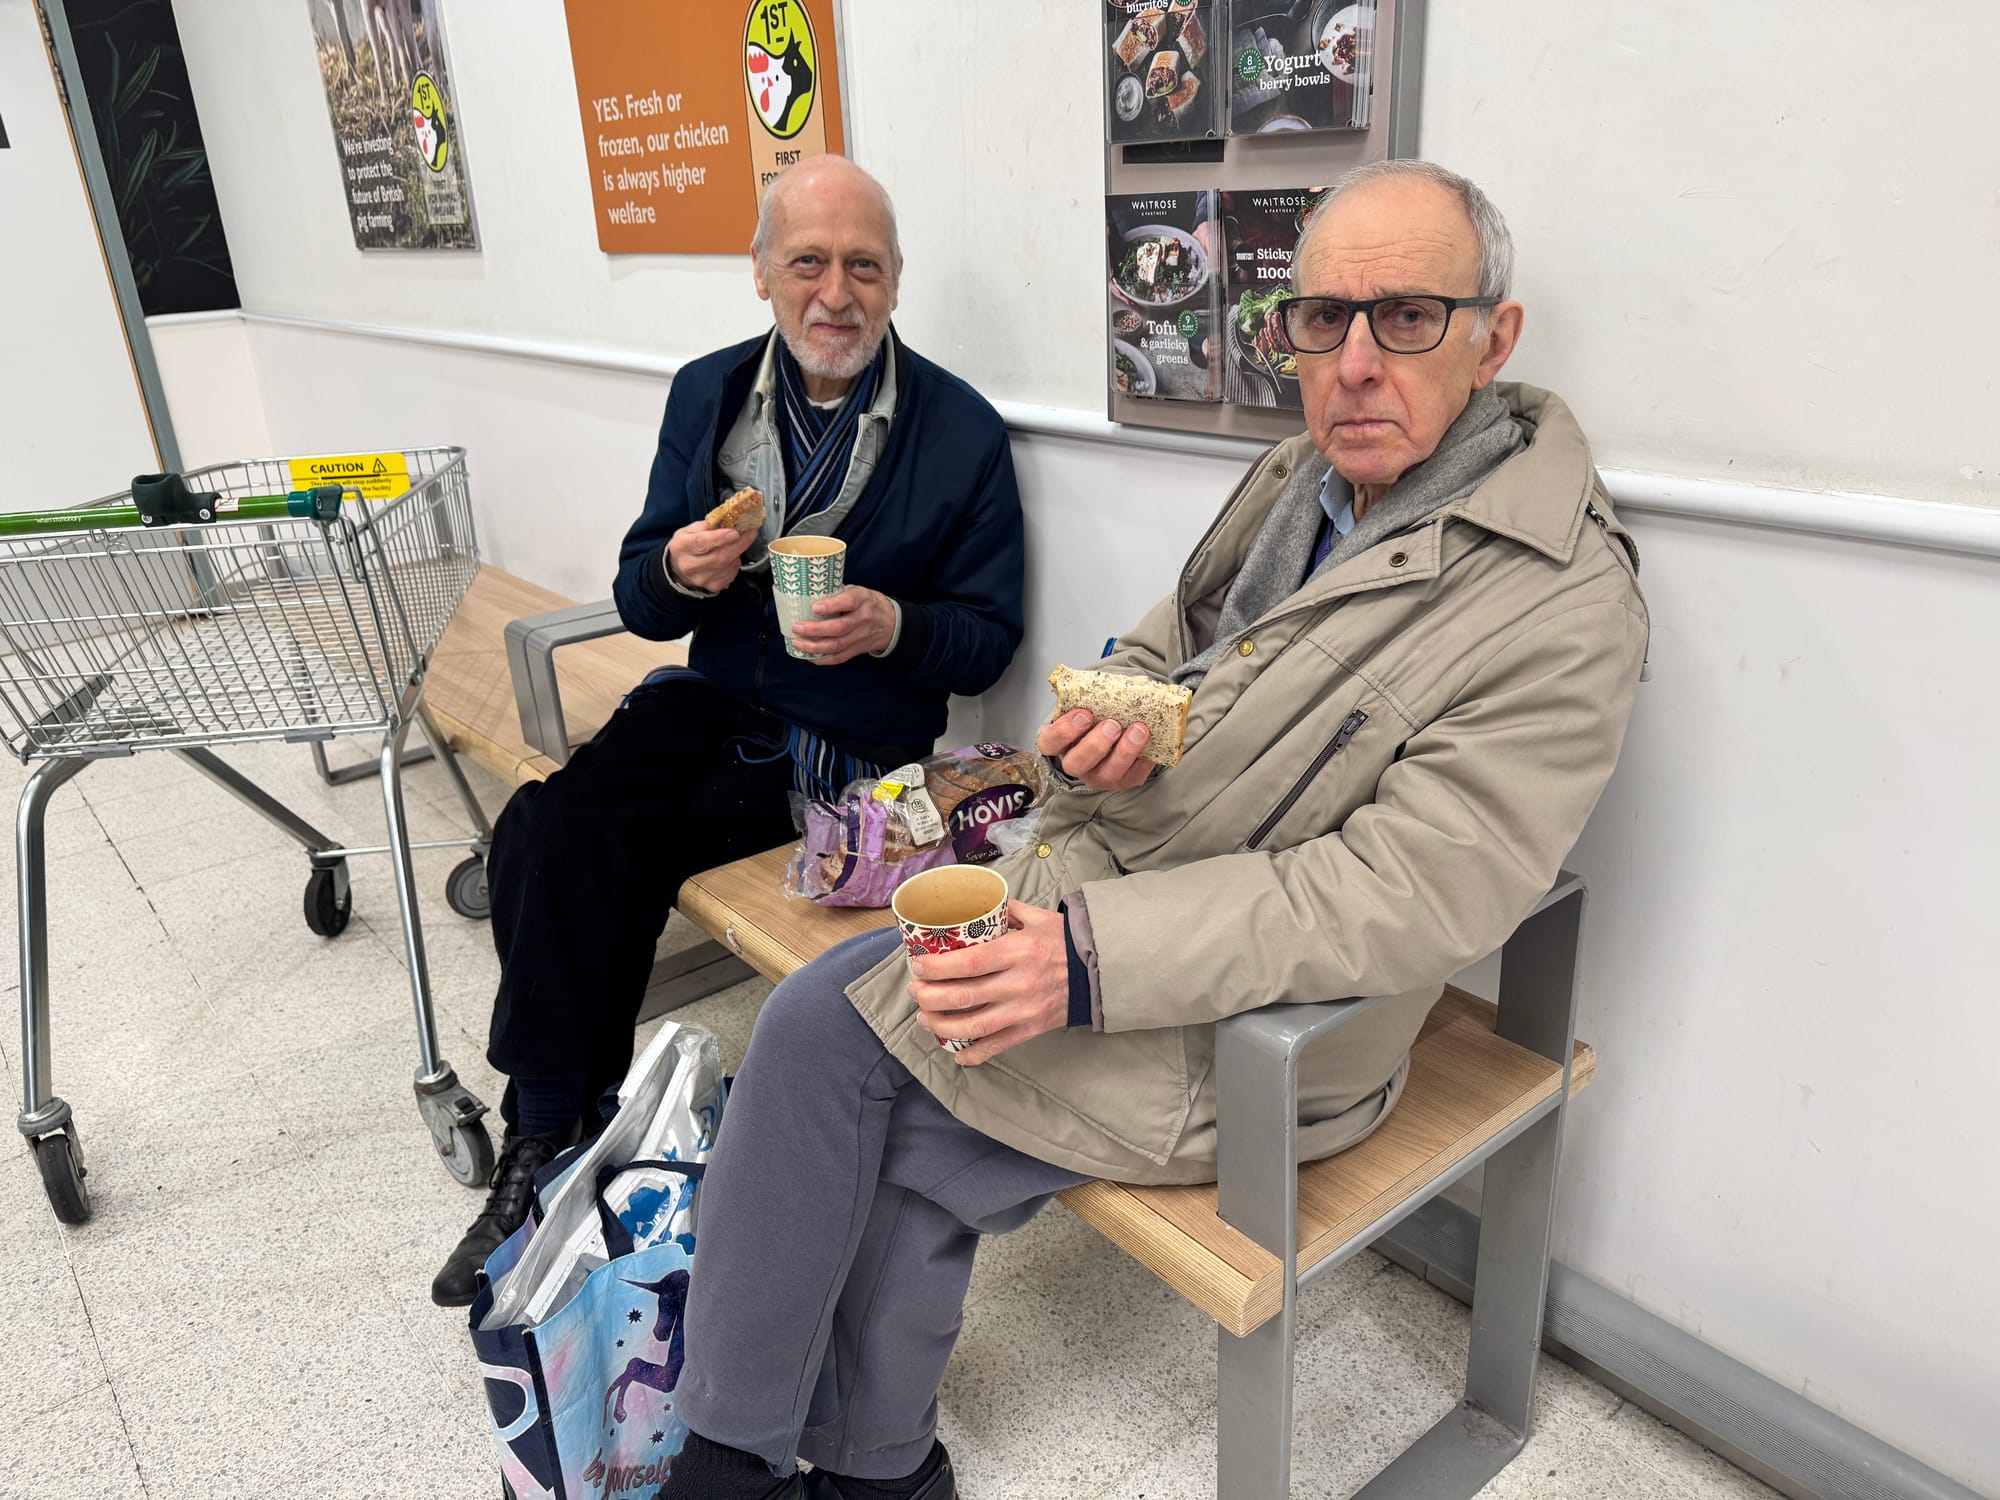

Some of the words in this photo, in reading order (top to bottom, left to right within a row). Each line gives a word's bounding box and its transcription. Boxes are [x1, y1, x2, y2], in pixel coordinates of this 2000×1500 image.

[1126, 0, 1168, 13] burritos
[761, 2, 788, 45] 1ST
[1247, 55, 1253, 66] 8
[1263, 50, 1322, 74] Yogurt
[1259, 77, 1293, 91] berry
[1294, 72, 1330, 87] bowls
[417, 83, 430, 110] 1ST
[593, 97, 624, 123] YES.
[626, 89, 663, 119] Fresh
[666, 91, 682, 112] or
[342, 139, 363, 156] We're
[363, 136, 394, 155] investing
[598, 132, 644, 158] frozen,
[647, 131, 670, 152] our
[674, 121, 729, 149] chicken
[775, 150, 801, 166] FIRST
[348, 166, 356, 180] to
[356, 163, 380, 184] protect
[381, 161, 393, 177] the
[603, 171, 614, 192] is
[618, 165, 660, 196] always
[662, 161, 706, 194] higher
[352, 187, 373, 204] future
[374, 186, 381, 202] of
[381, 184, 404, 202] British
[1252, 196, 1306, 207] WAITROSE
[608, 201, 656, 225] welfare
[1132, 199, 1177, 210] WAITROSE
[357, 214, 368, 233] pig
[368, 211, 394, 232] farming
[1257, 247, 1293, 262] Sticky
[1146, 320, 1177, 335] Tofu
[1185, 315, 1191, 324] 9
[1140, 338, 1148, 348] &
[1149, 338, 1188, 352] garlicky
[1156, 354, 1189, 365] greens
[310, 463, 364, 474] CAUTION
[957, 791, 1024, 831] HOVIS
